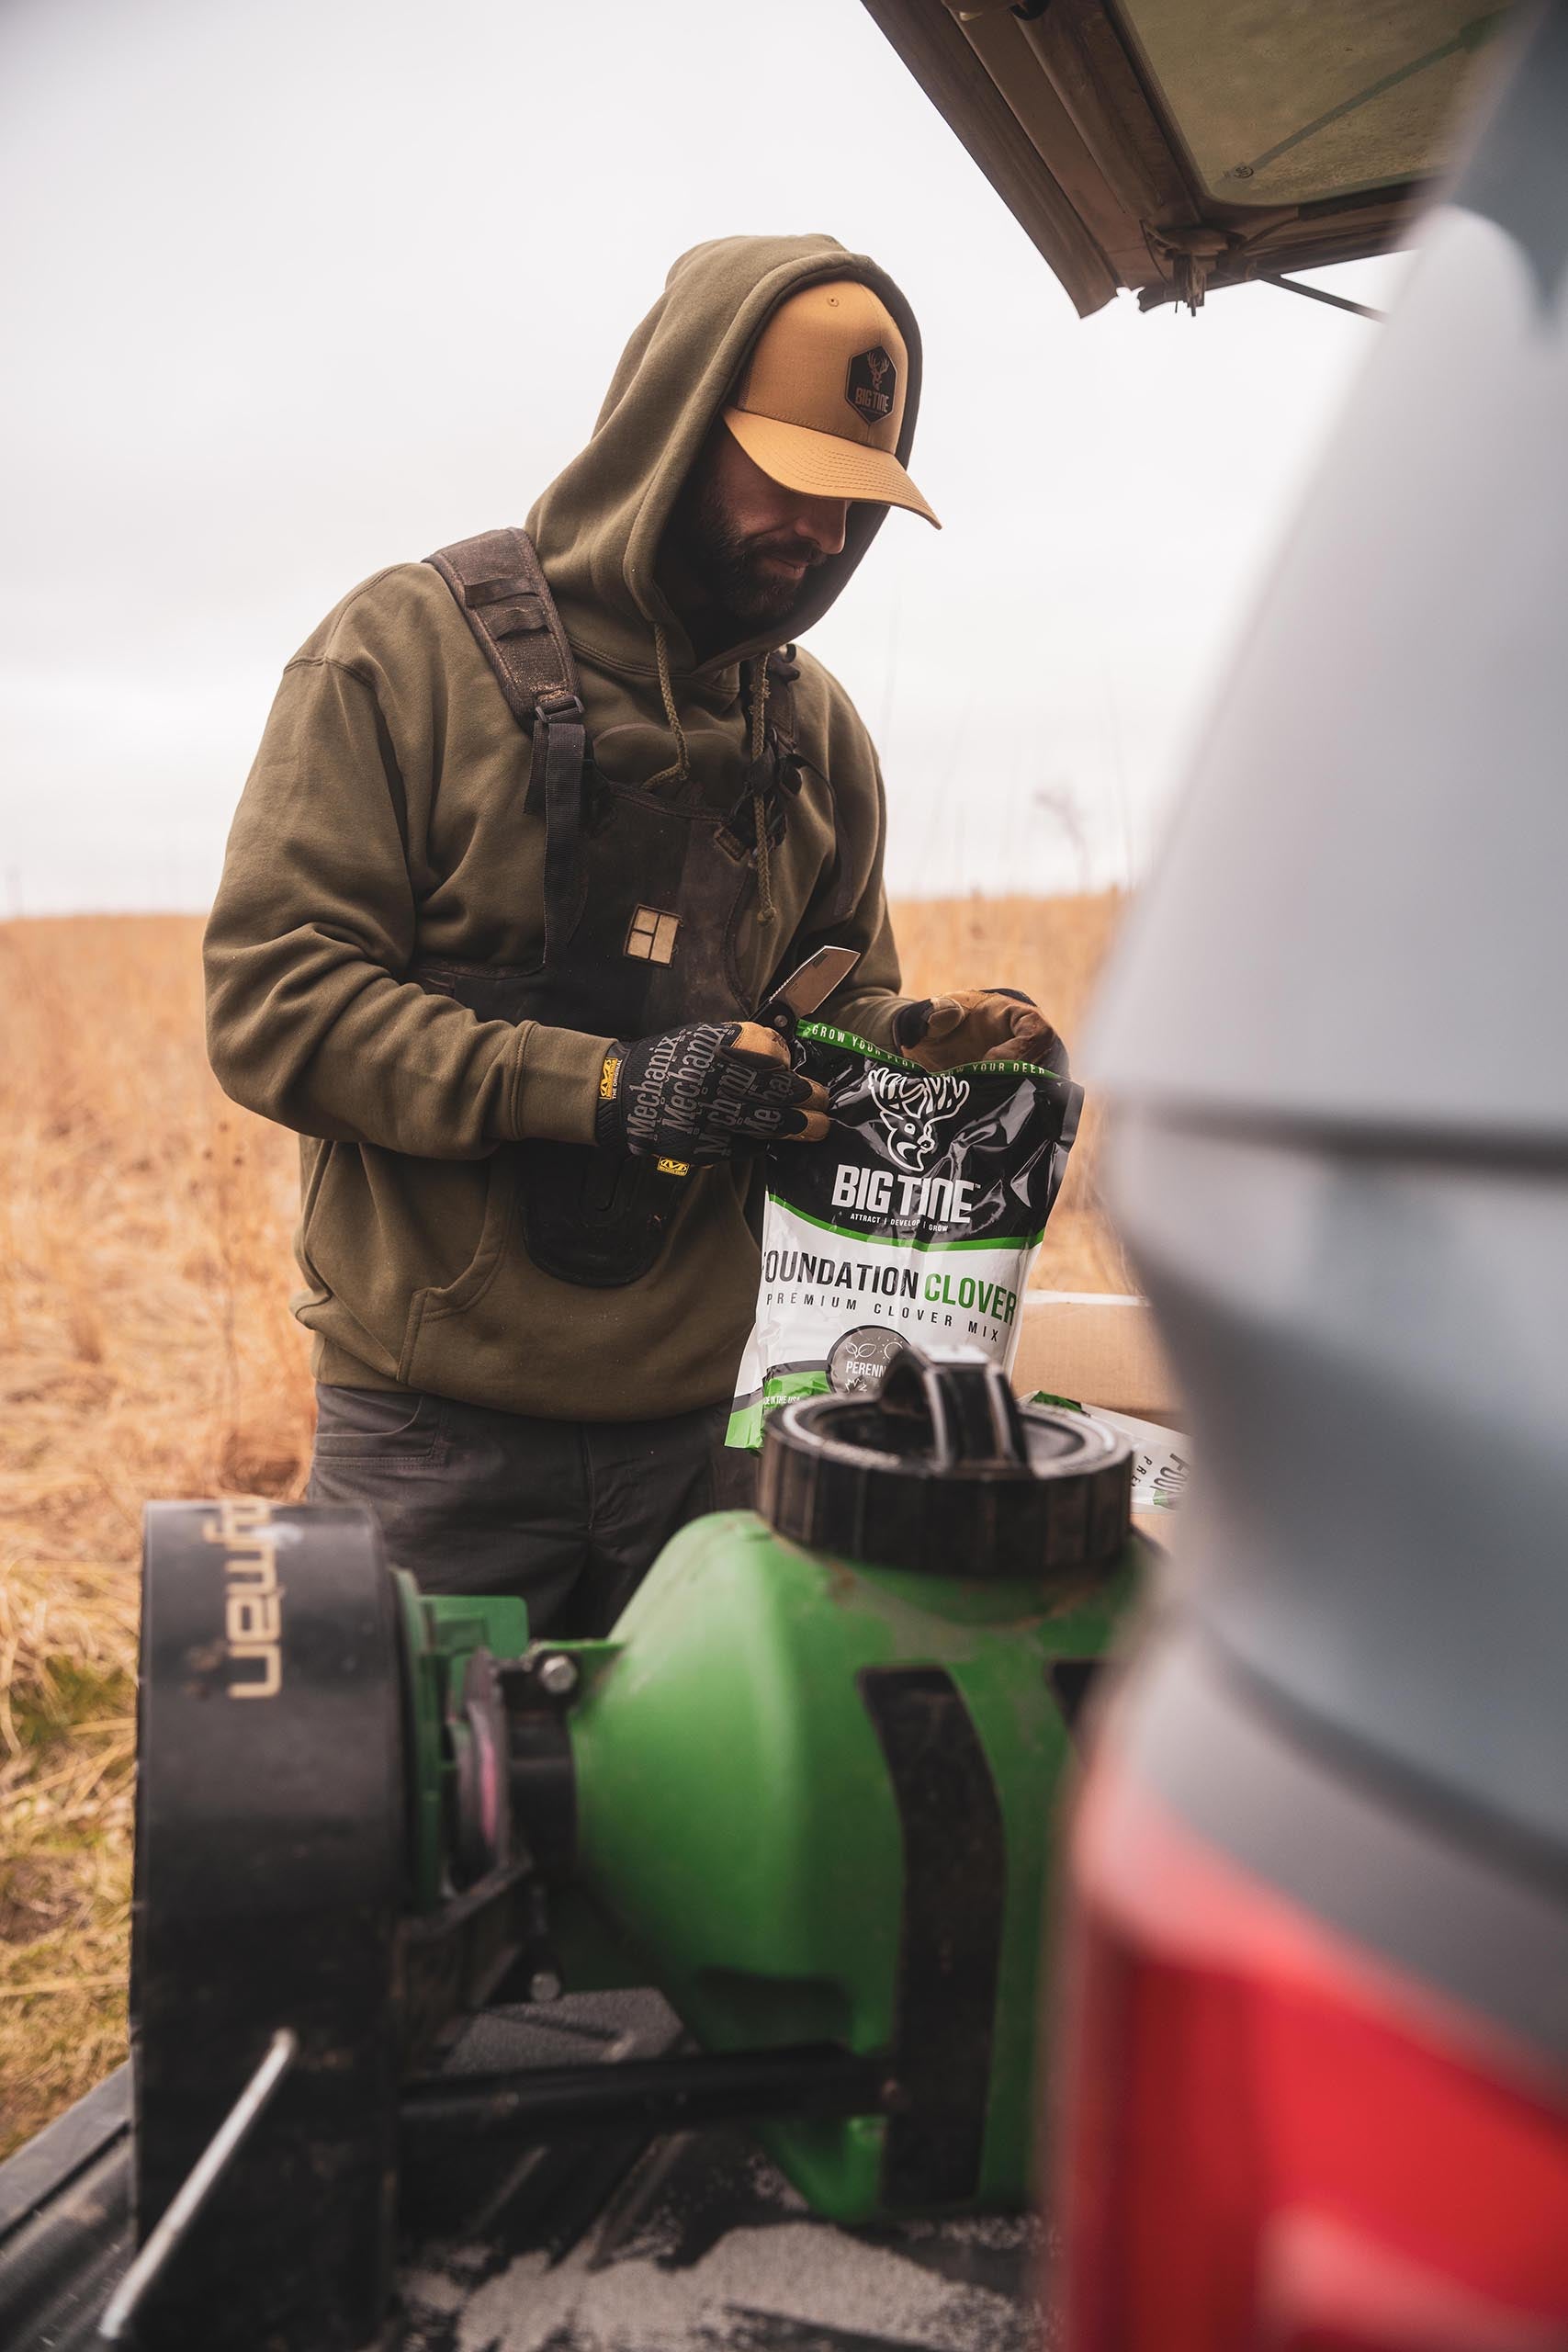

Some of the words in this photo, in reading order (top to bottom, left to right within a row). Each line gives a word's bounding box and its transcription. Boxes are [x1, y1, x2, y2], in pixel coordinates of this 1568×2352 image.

[855, 387, 872, 406] BIG
[812, 1024, 845, 1043] GROW
[972, 1062, 1005, 1072] YOUR
[613, 1058, 624, 1087] ORIGINAL
[626, 1035, 682, 1139] Mechanix
[661, 1023, 728, 1133] Mechanix
[831, 1164, 895, 1214] BIG
[897, 1174, 975, 1224] TINE
[851, 1213, 881, 1225] ATTRACT
[929, 1224, 949, 1232] GROW
[762, 1250, 919, 1299] OUNDATION
[924, 1272, 1017, 1326] CLOVER
[767, 1292, 857, 1310] PREMIUM
[874, 1303, 953, 1327] CLOVER
[968, 1320, 998, 1341] MIX
[845, 1360, 886, 1378] PERENN
[776, 1395, 787, 1404] THE
